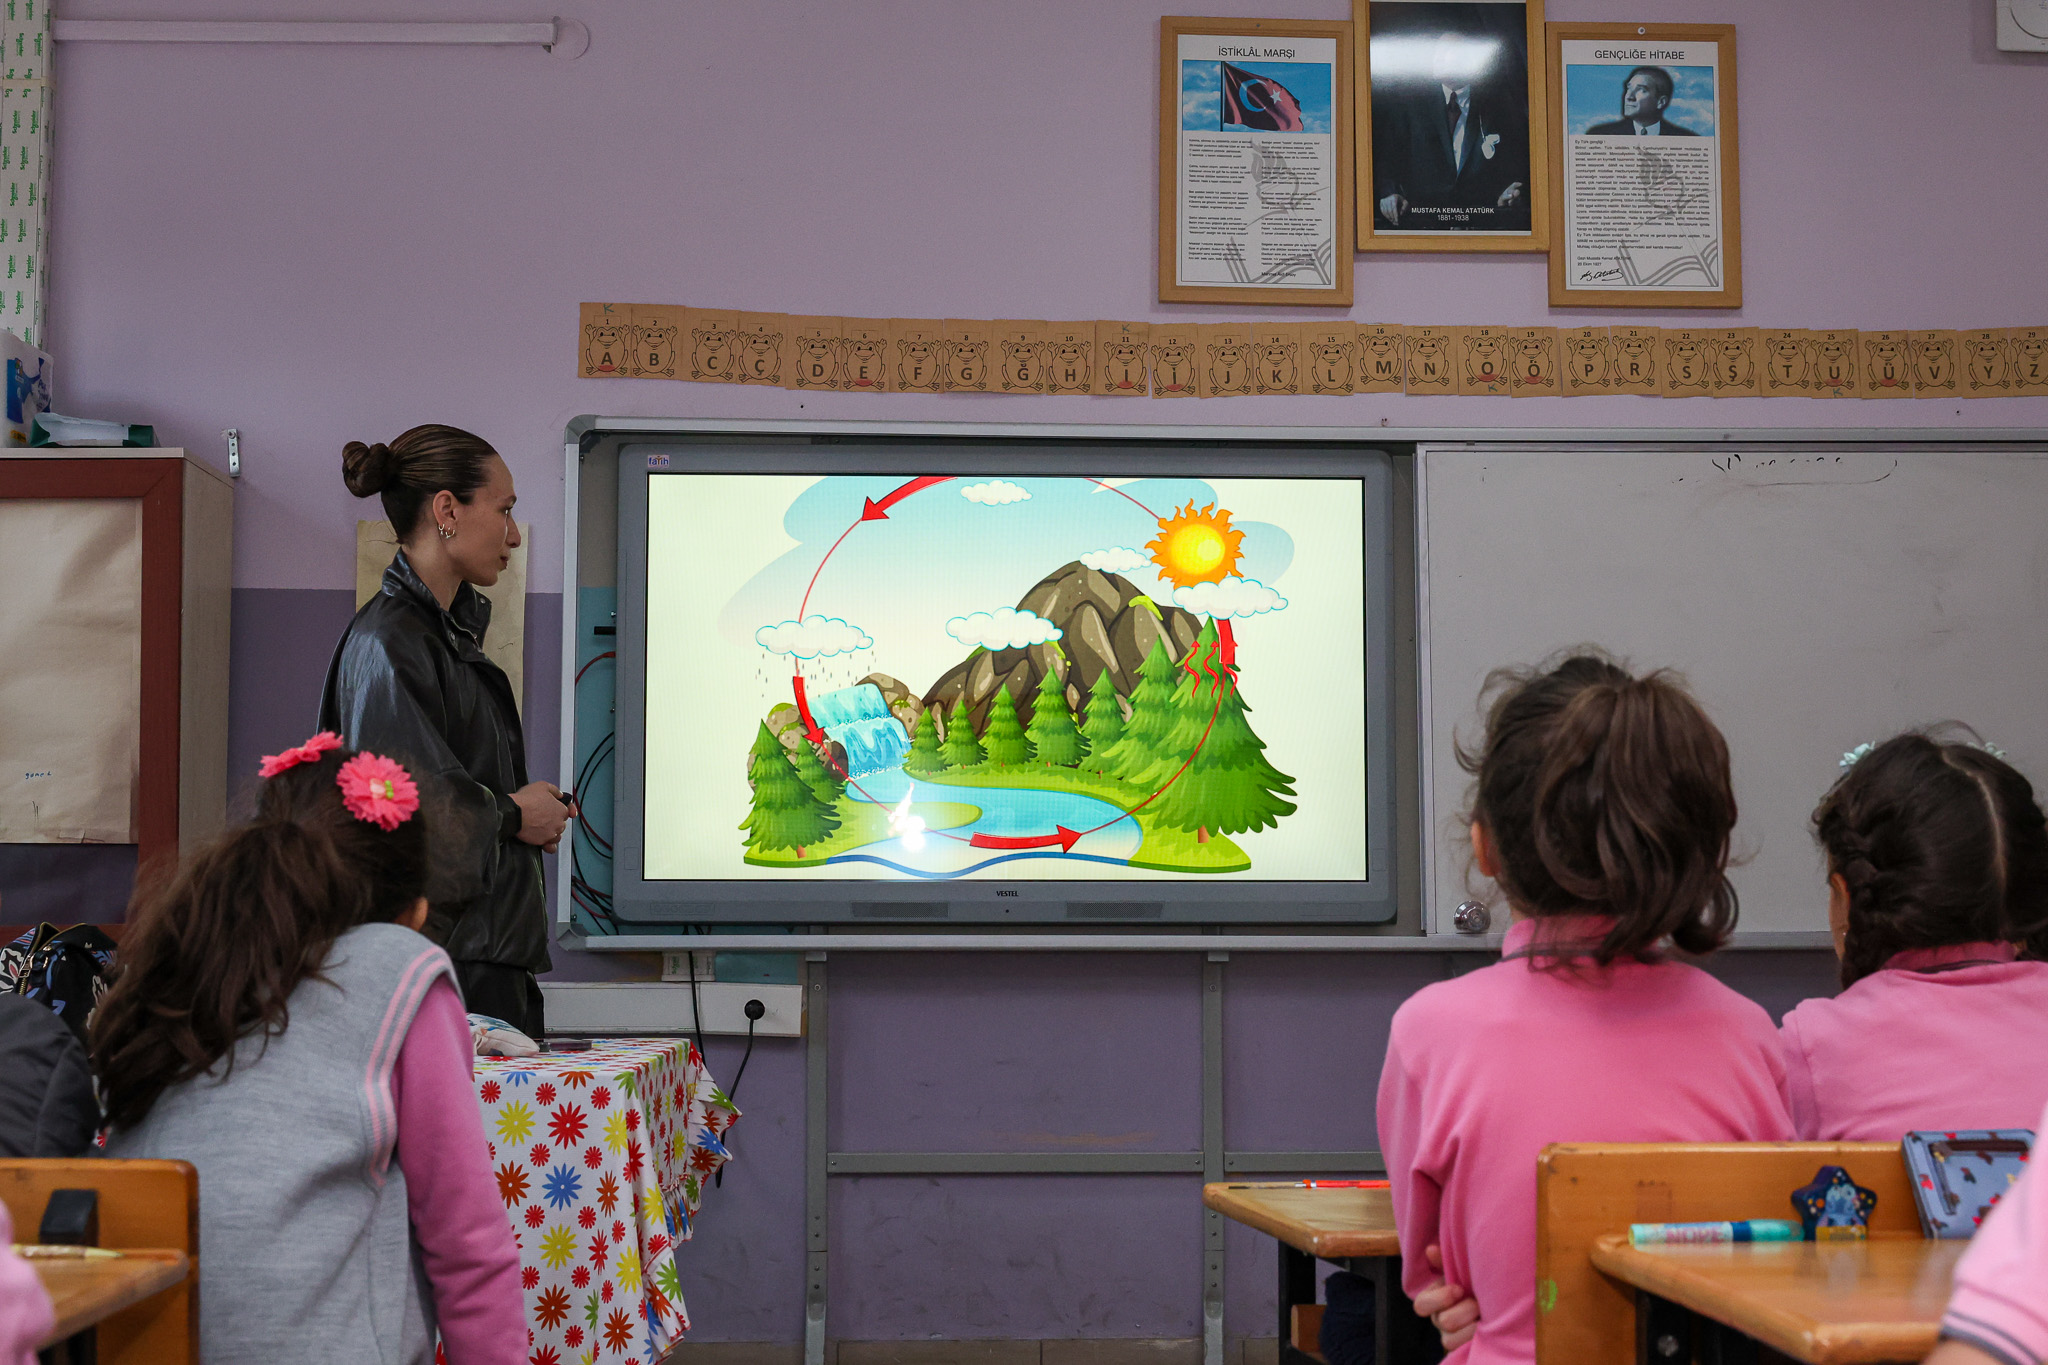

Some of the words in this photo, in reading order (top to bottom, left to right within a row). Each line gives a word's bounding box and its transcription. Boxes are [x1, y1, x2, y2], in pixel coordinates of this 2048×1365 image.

[1218, 45, 1261, 57] İSTİKLÂL
[1263, 48, 1296, 59] MARŞI
[1594, 48, 1647, 60] GENÇLİĞE
[1649, 49, 1685, 60] HİTABE
[1465, 206, 1495, 214] ATATÜRK
[1376, 327, 1385, 335] 16
[1827, 333, 1836, 341] 25
[600, 351, 613, 366] A
[649, 352, 660, 367] B
[707, 356, 718, 370] C
[754, 359, 765, 376] Ç
[812, 363, 824, 378] D
[859, 365, 868, 380] E
[914, 366, 922, 381] F
[960, 367, 973, 381] G
[1064, 368, 1076, 383] H
[1224, 370, 1231, 385] J
[1272, 369, 1283, 384] K
[1327, 369, 1336, 383] L
[1375, 360, 1393, 376] M
[1424, 362, 1436, 376] N
[1481, 361, 1494, 376] O
[1584, 363, 1594, 377] P
[1629, 362, 1640, 376] R
[1682, 365, 1692, 380] S
[1728, 364, 1738, 383] Ş
[1782, 364, 1793, 379] T
[1828, 366, 1841, 380] U
[1928, 365, 1941, 380] V
[1983, 365, 1994, 379] Y
[2029, 363, 2040, 378] Z
